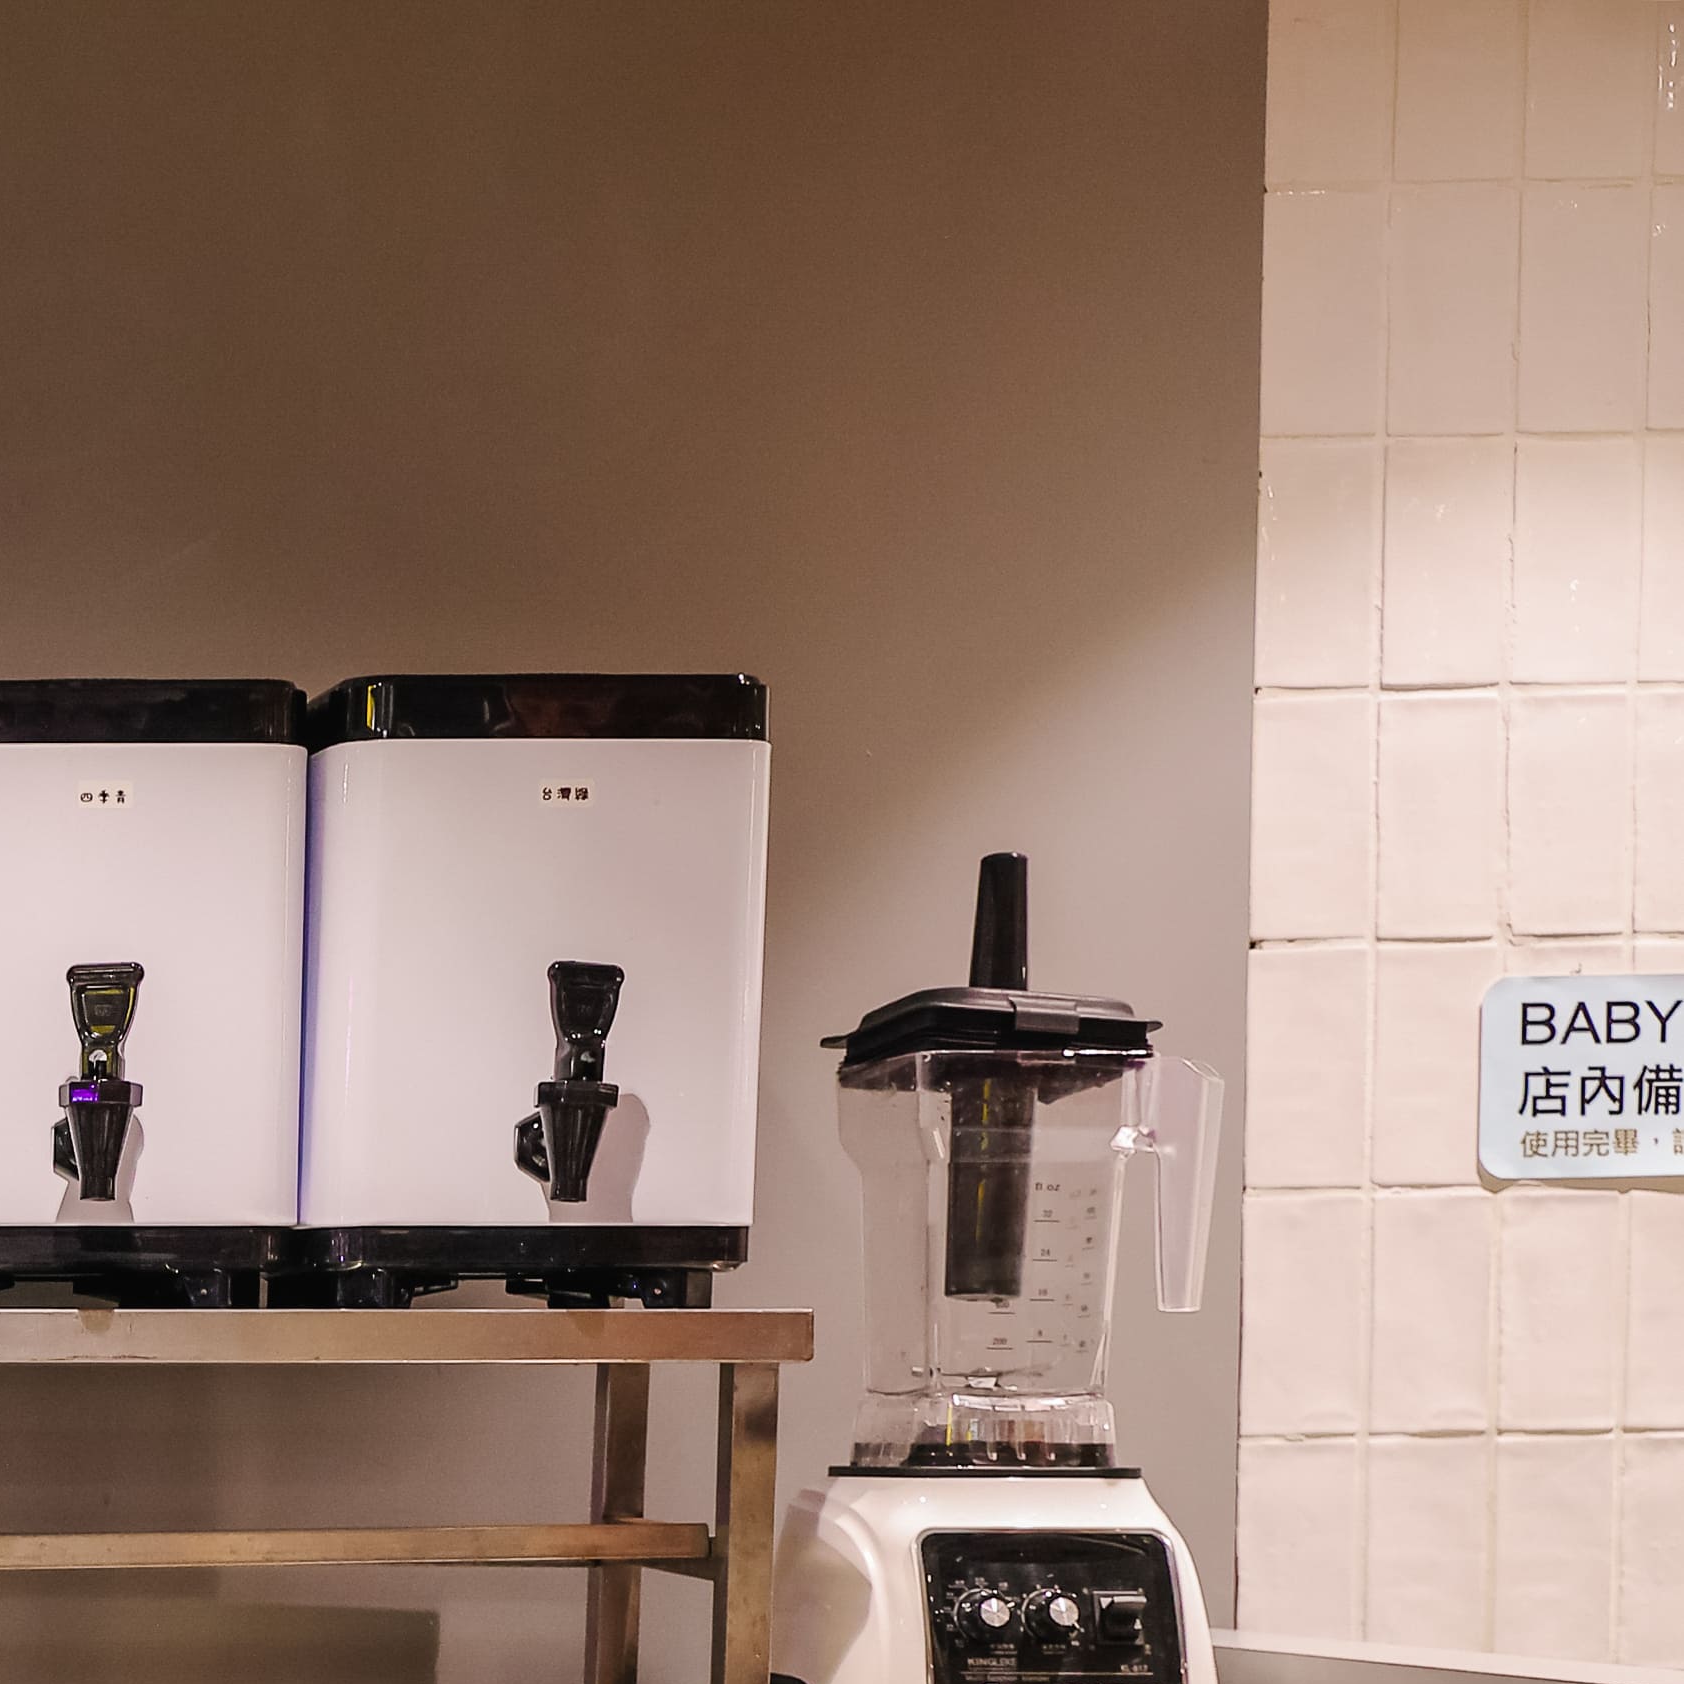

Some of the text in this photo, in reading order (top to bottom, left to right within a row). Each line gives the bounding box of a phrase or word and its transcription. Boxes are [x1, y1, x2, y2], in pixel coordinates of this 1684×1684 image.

[1521, 1000, 1683, 1046] BABY
[1518, 1064, 1684, 1117] 店內備
